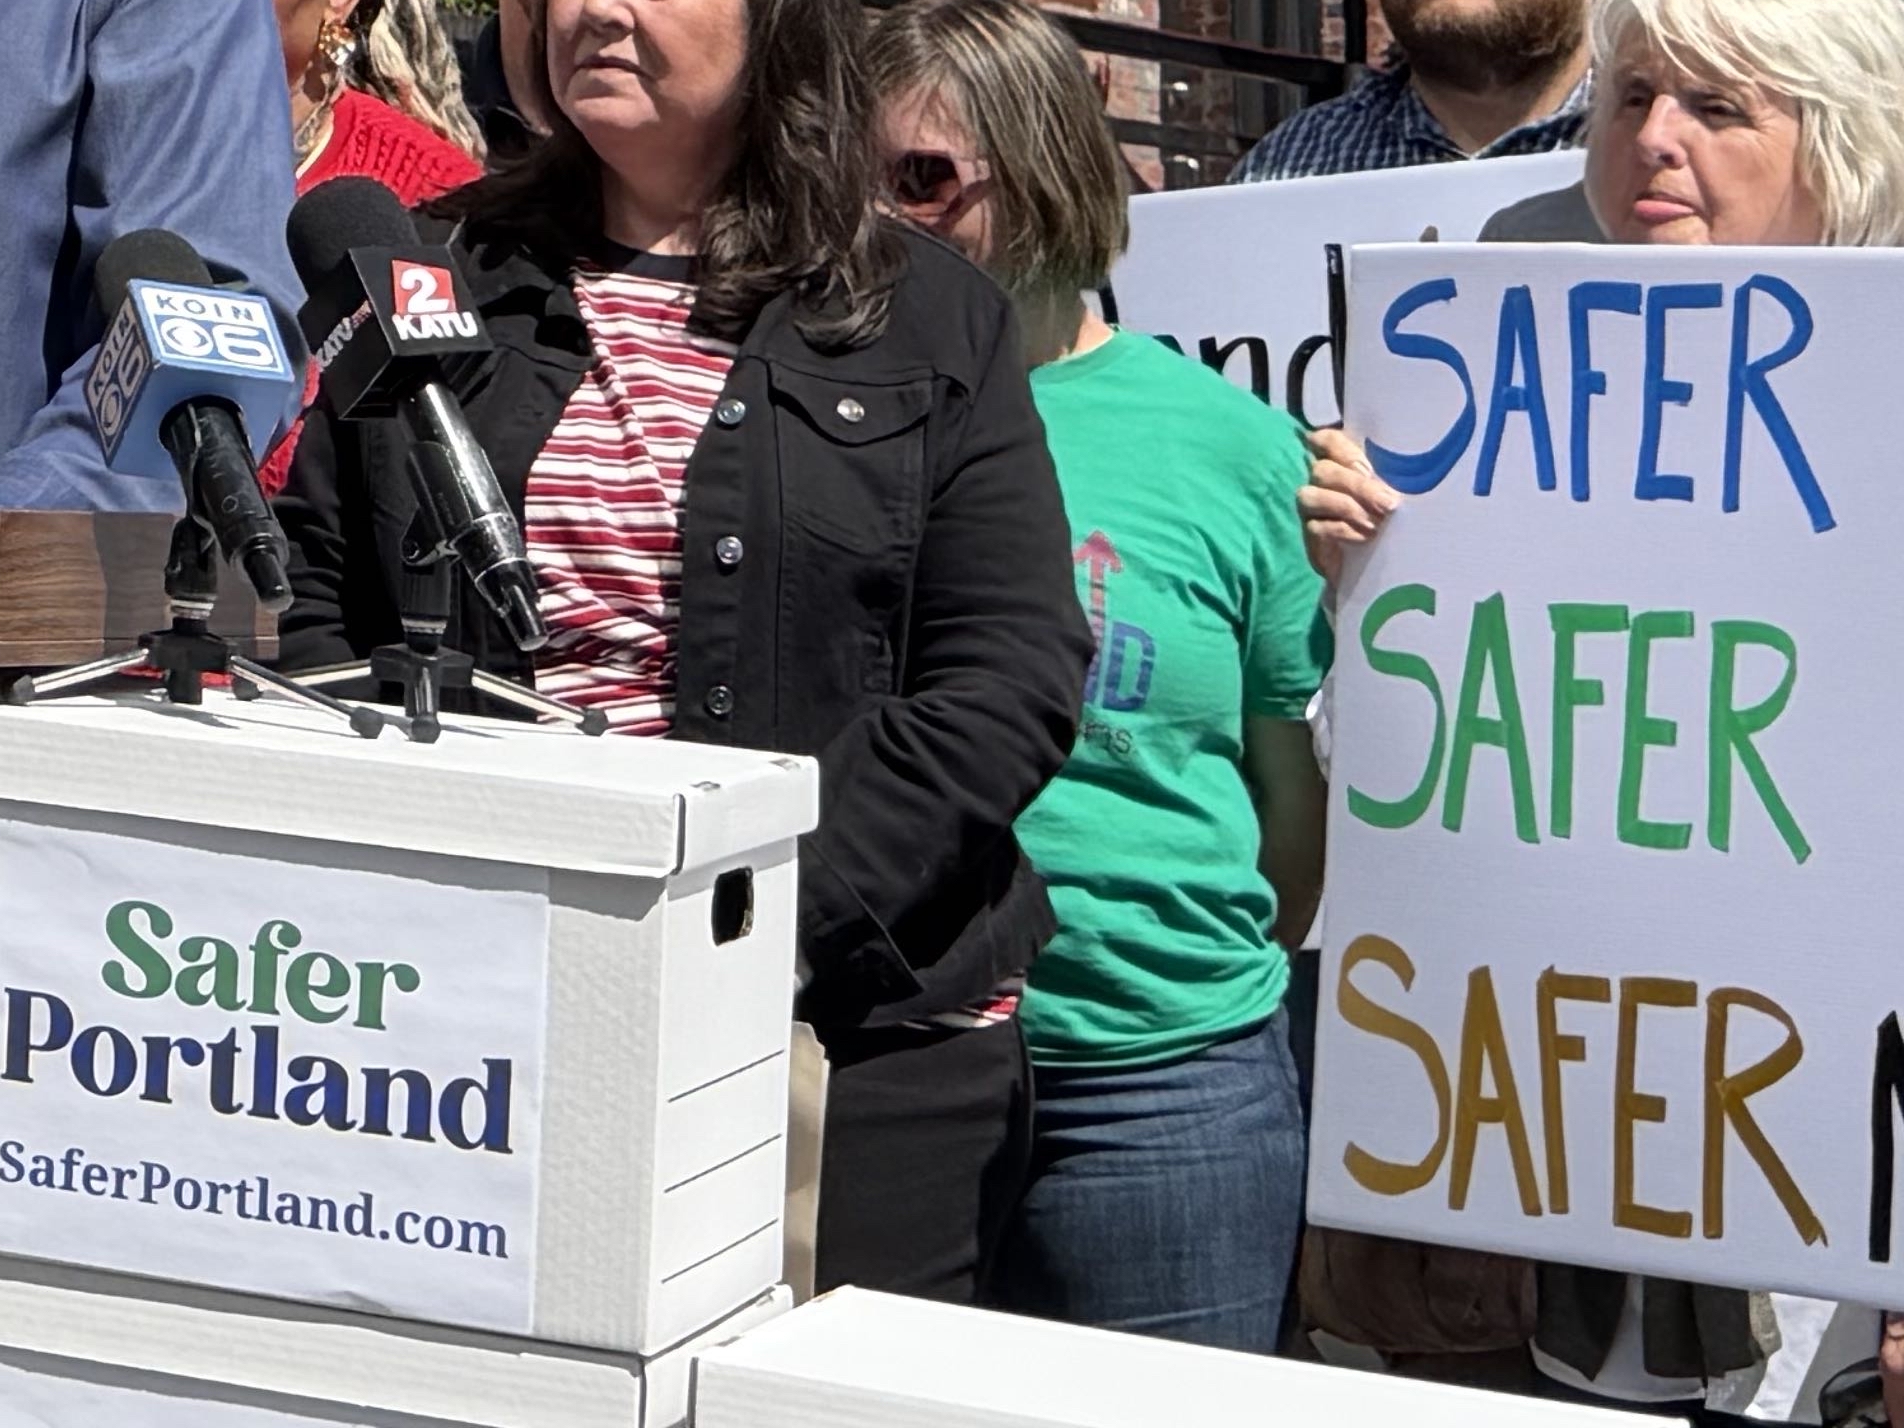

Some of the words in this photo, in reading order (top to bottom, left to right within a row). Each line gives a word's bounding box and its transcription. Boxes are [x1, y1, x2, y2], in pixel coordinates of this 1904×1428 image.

[156, 294, 254, 322] KOIN
[392, 311, 478, 340] KATU
[400, 267, 450, 313] 2
[1363, 274, 1836, 533] SAFER
[1346, 582, 1812, 866] SAFER
[101, 900, 421, 1031] Safer
[0, 988, 512, 1154] Portland
[1337, 934, 1828, 1248] SAFER
